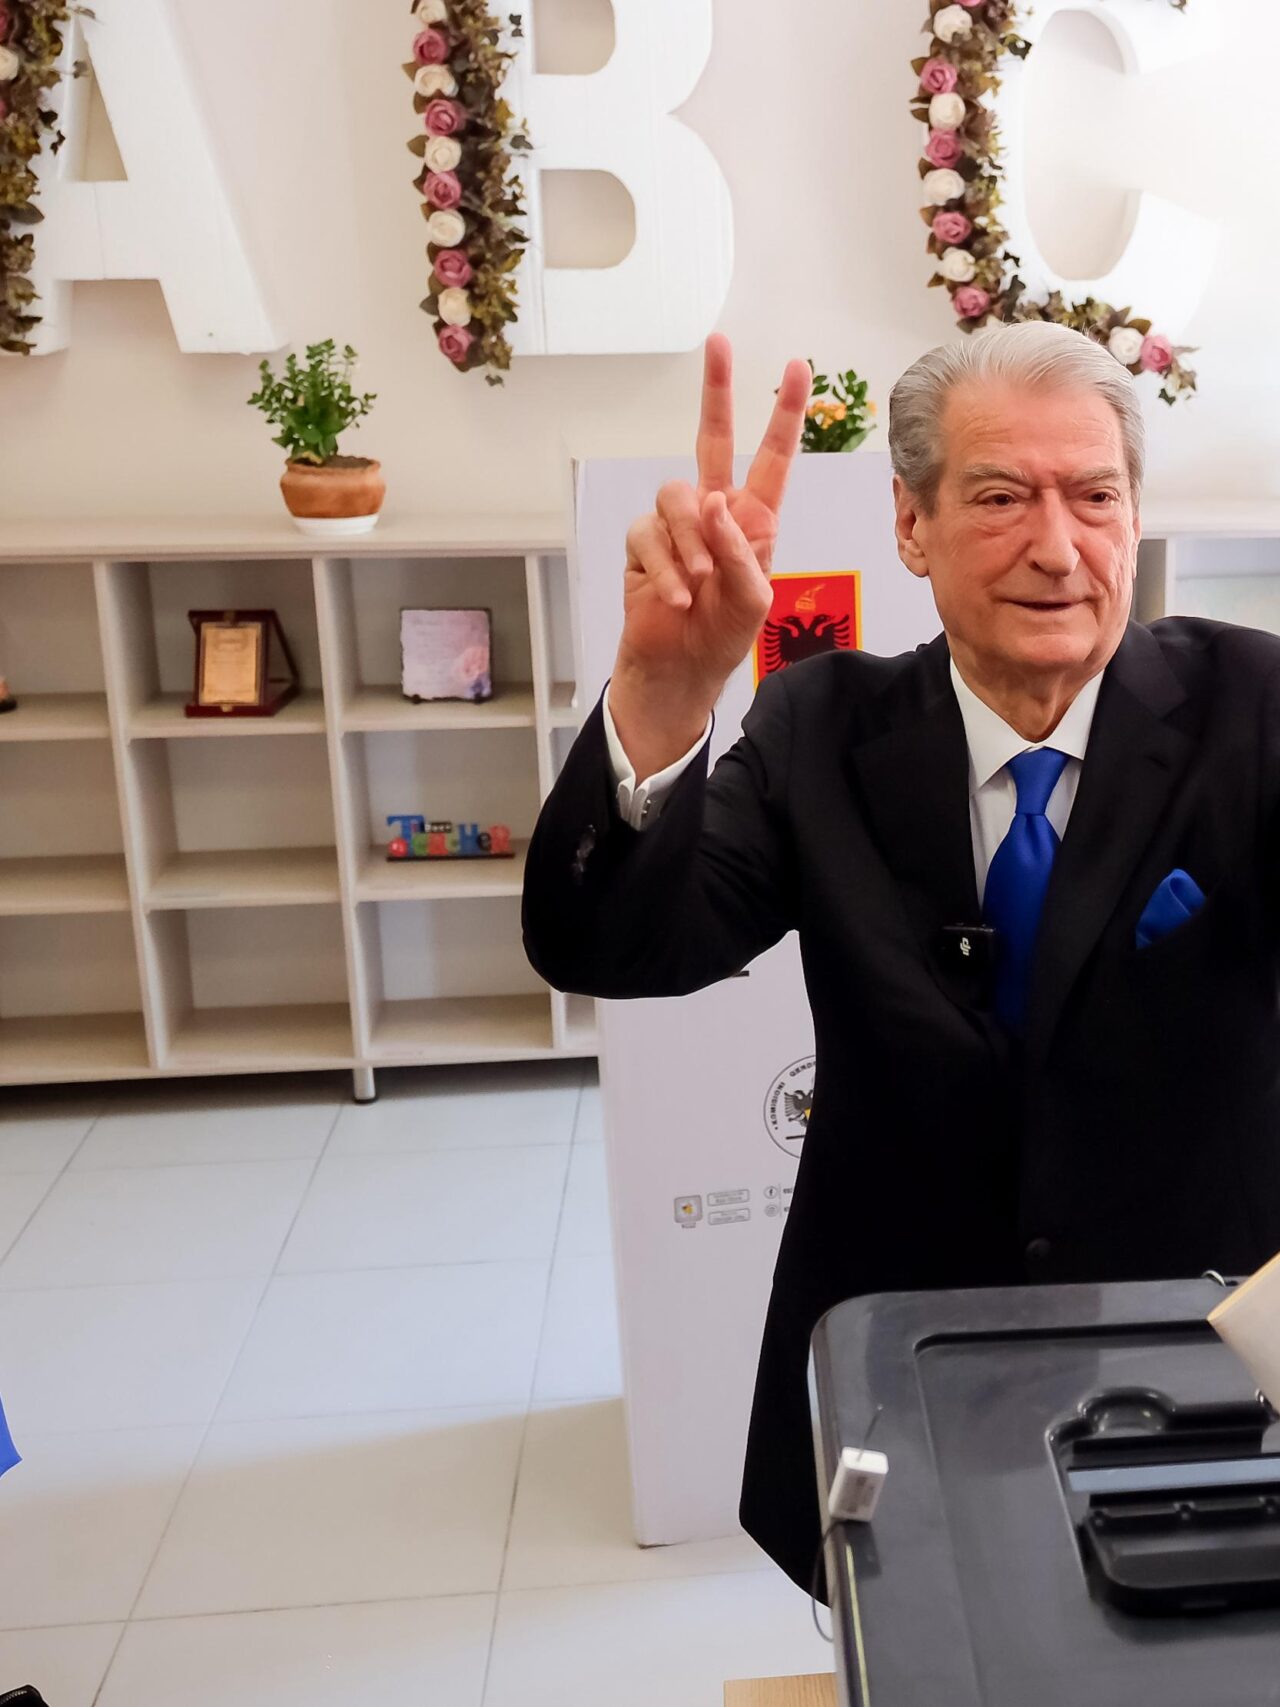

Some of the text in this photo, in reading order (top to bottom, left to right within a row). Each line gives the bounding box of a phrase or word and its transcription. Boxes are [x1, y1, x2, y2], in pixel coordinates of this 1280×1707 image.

[0, 0, 1218, 402] A B C
